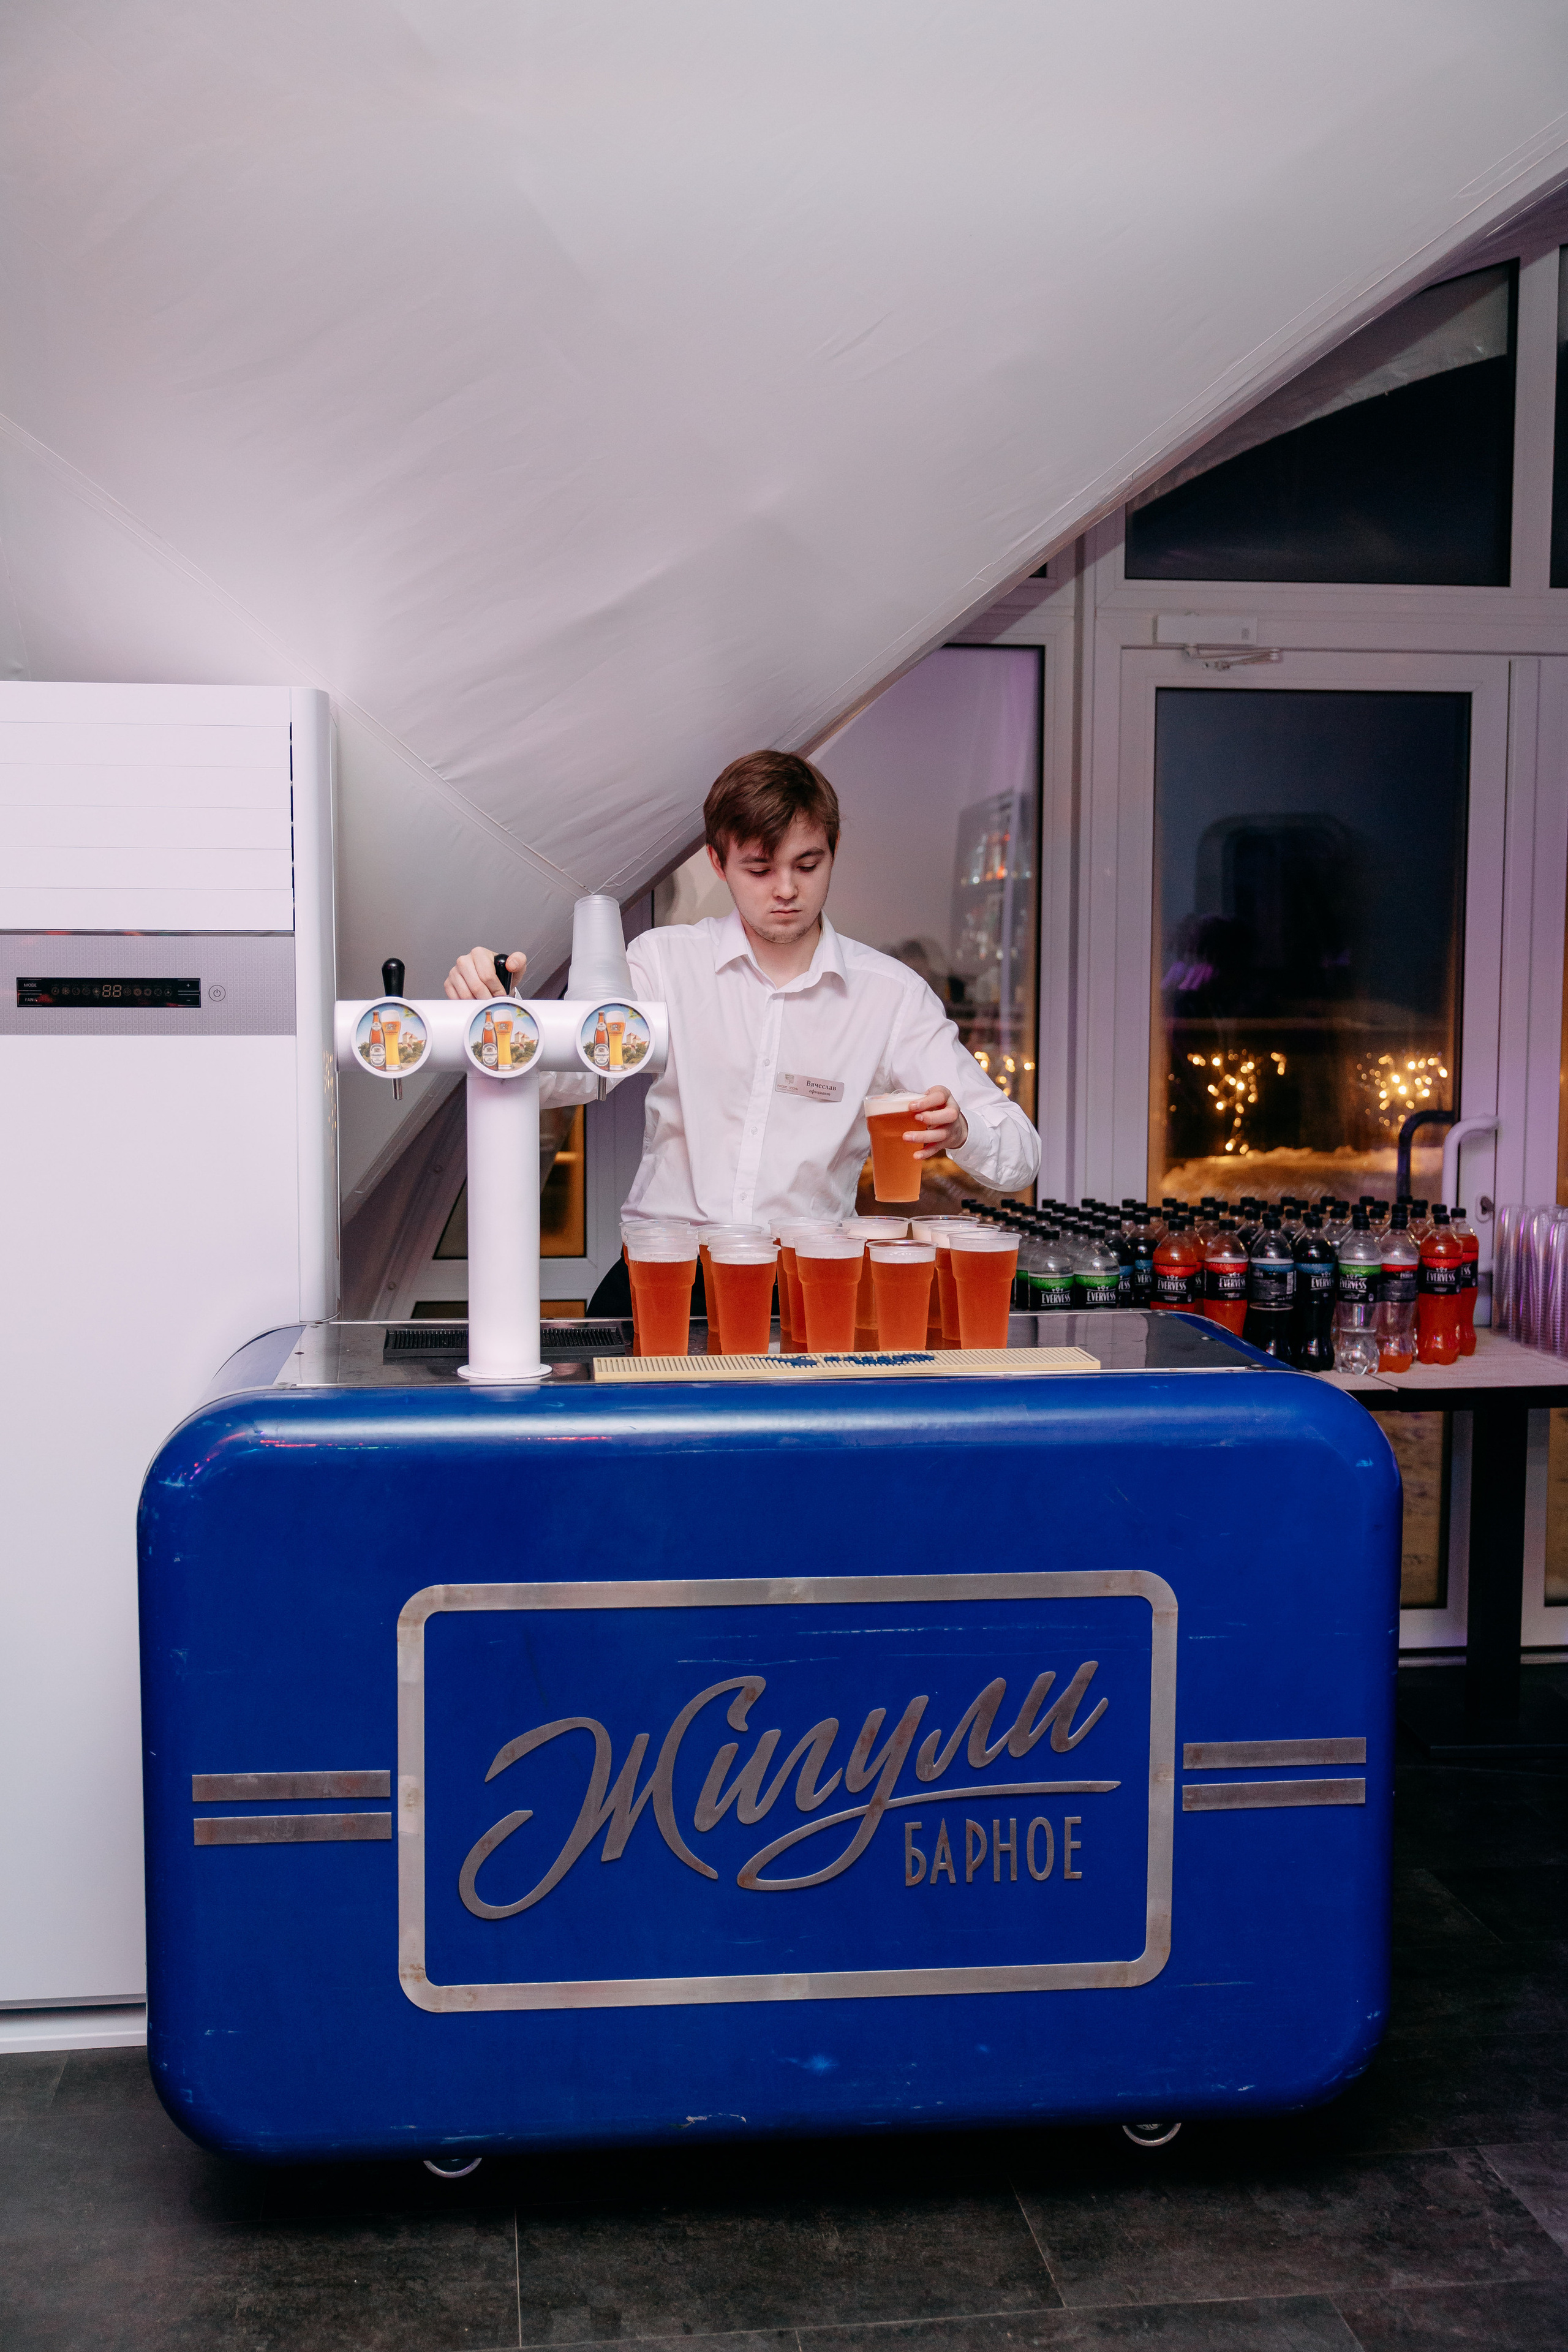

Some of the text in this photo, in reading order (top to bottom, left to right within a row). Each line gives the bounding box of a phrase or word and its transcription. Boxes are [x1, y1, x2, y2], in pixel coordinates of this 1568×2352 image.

[806, 1080, 837, 1091] Вячеслав
[1157, 1280, 1186, 1291] EVERVESS
[1340, 1278, 1366, 1289] EVERVESS
[1042, 1291, 1071, 1303] EVERVESS
[1087, 1290, 1116, 1302] EVERVESS
[458, 1660, 1121, 1920] Жигули
[904, 1816, 1083, 1887] БАРНОЕ
